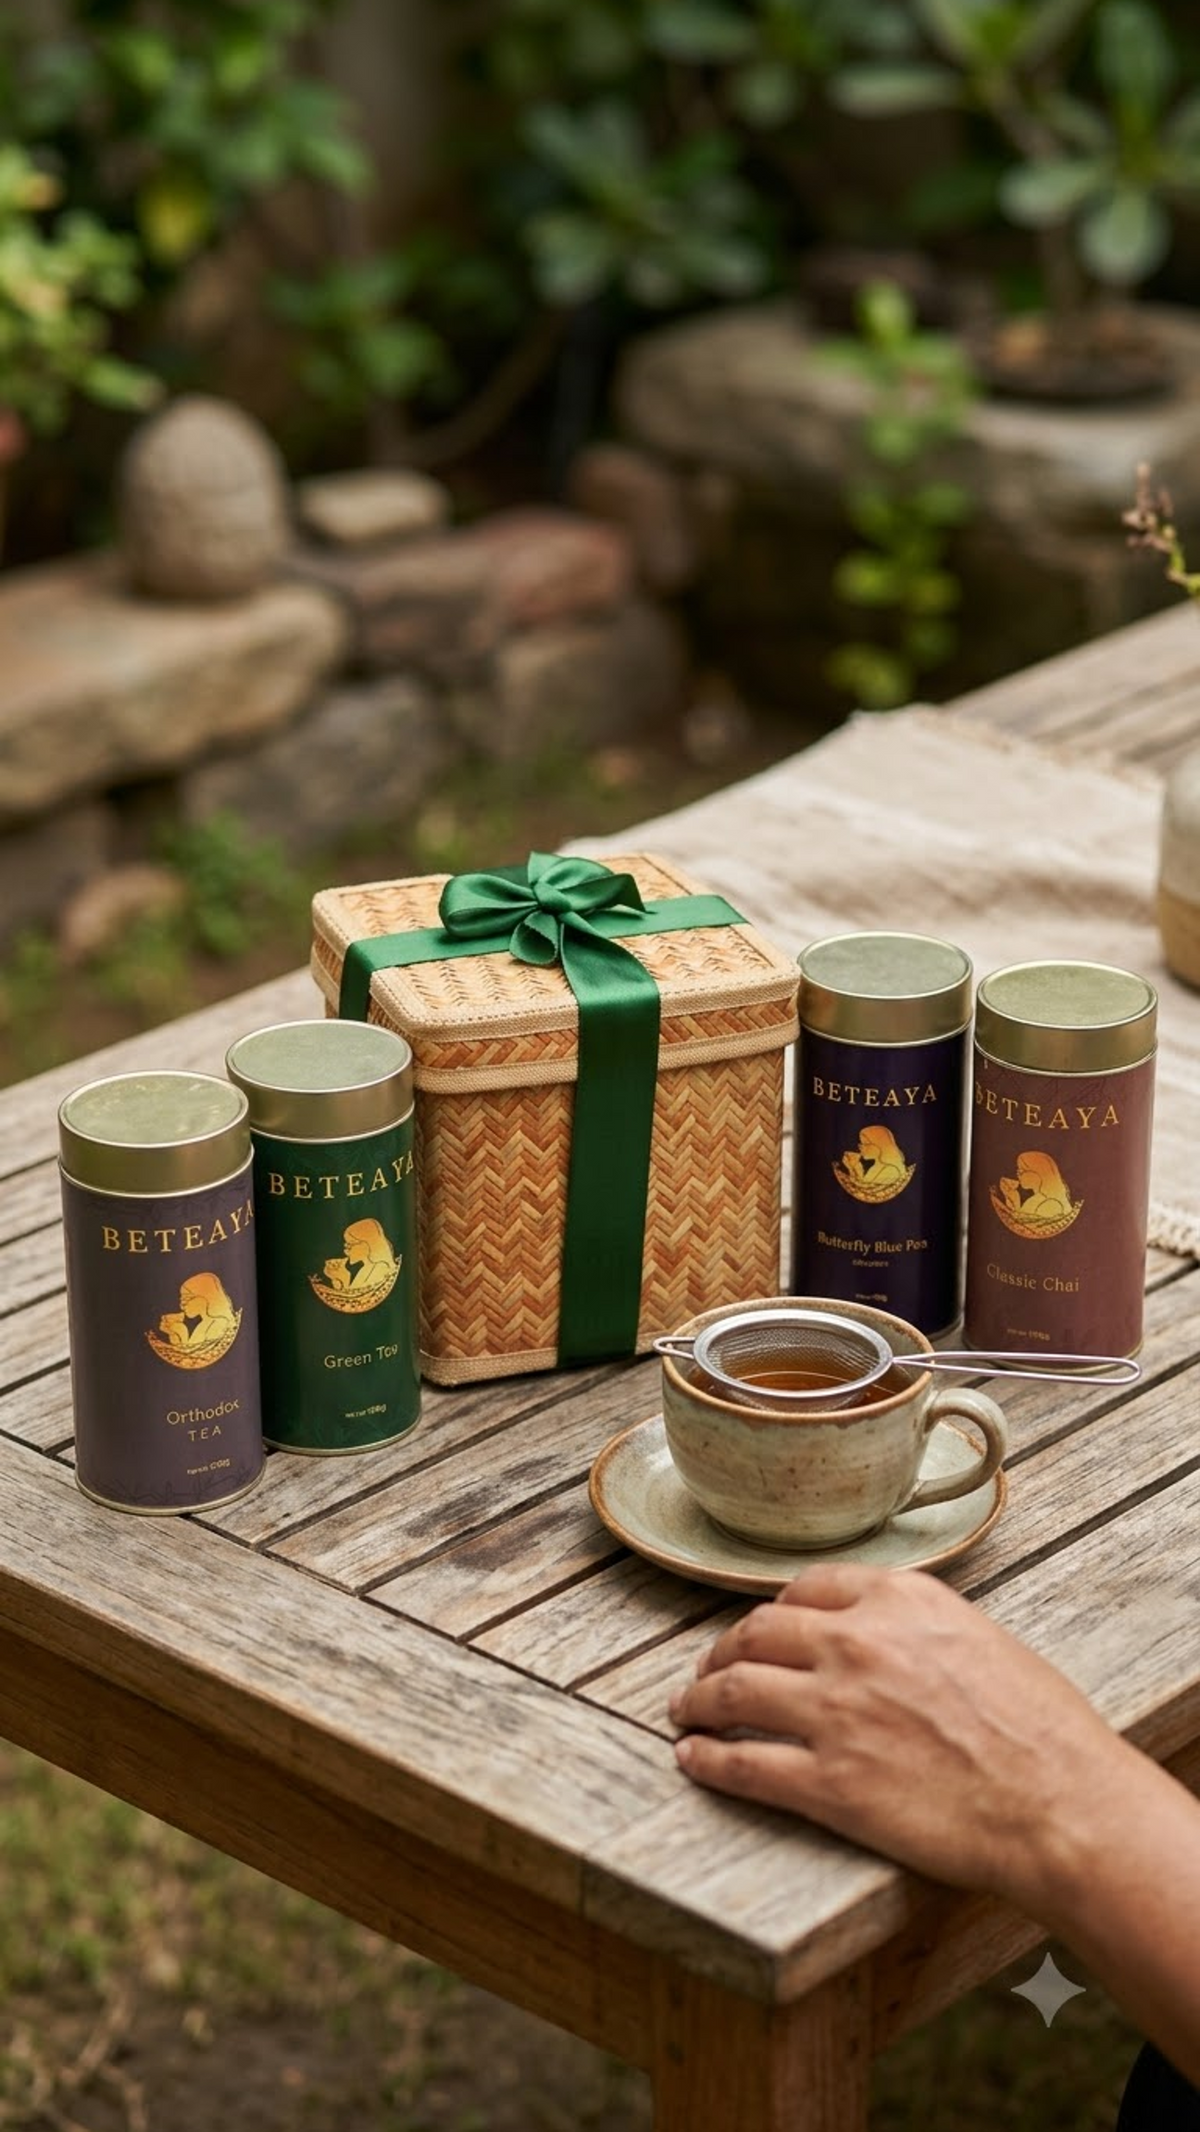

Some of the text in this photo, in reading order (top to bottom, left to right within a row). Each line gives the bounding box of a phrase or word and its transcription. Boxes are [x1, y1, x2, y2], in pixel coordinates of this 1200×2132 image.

[813, 1077, 937, 1107] BETEAYA
[975, 1081, 1120, 1129] BETEAYA
[268, 1150, 414, 1199] BETEAYA
[102, 1199, 254, 1253] BETEAYA
[818, 1231, 871, 1256] Butterfly
[874, 1241, 903, 1253] Blue
[1042, 1277, 1079, 1292] Chai
[324, 1354, 372, 1368] Green
[187, 1425, 221, 1441] TEA
